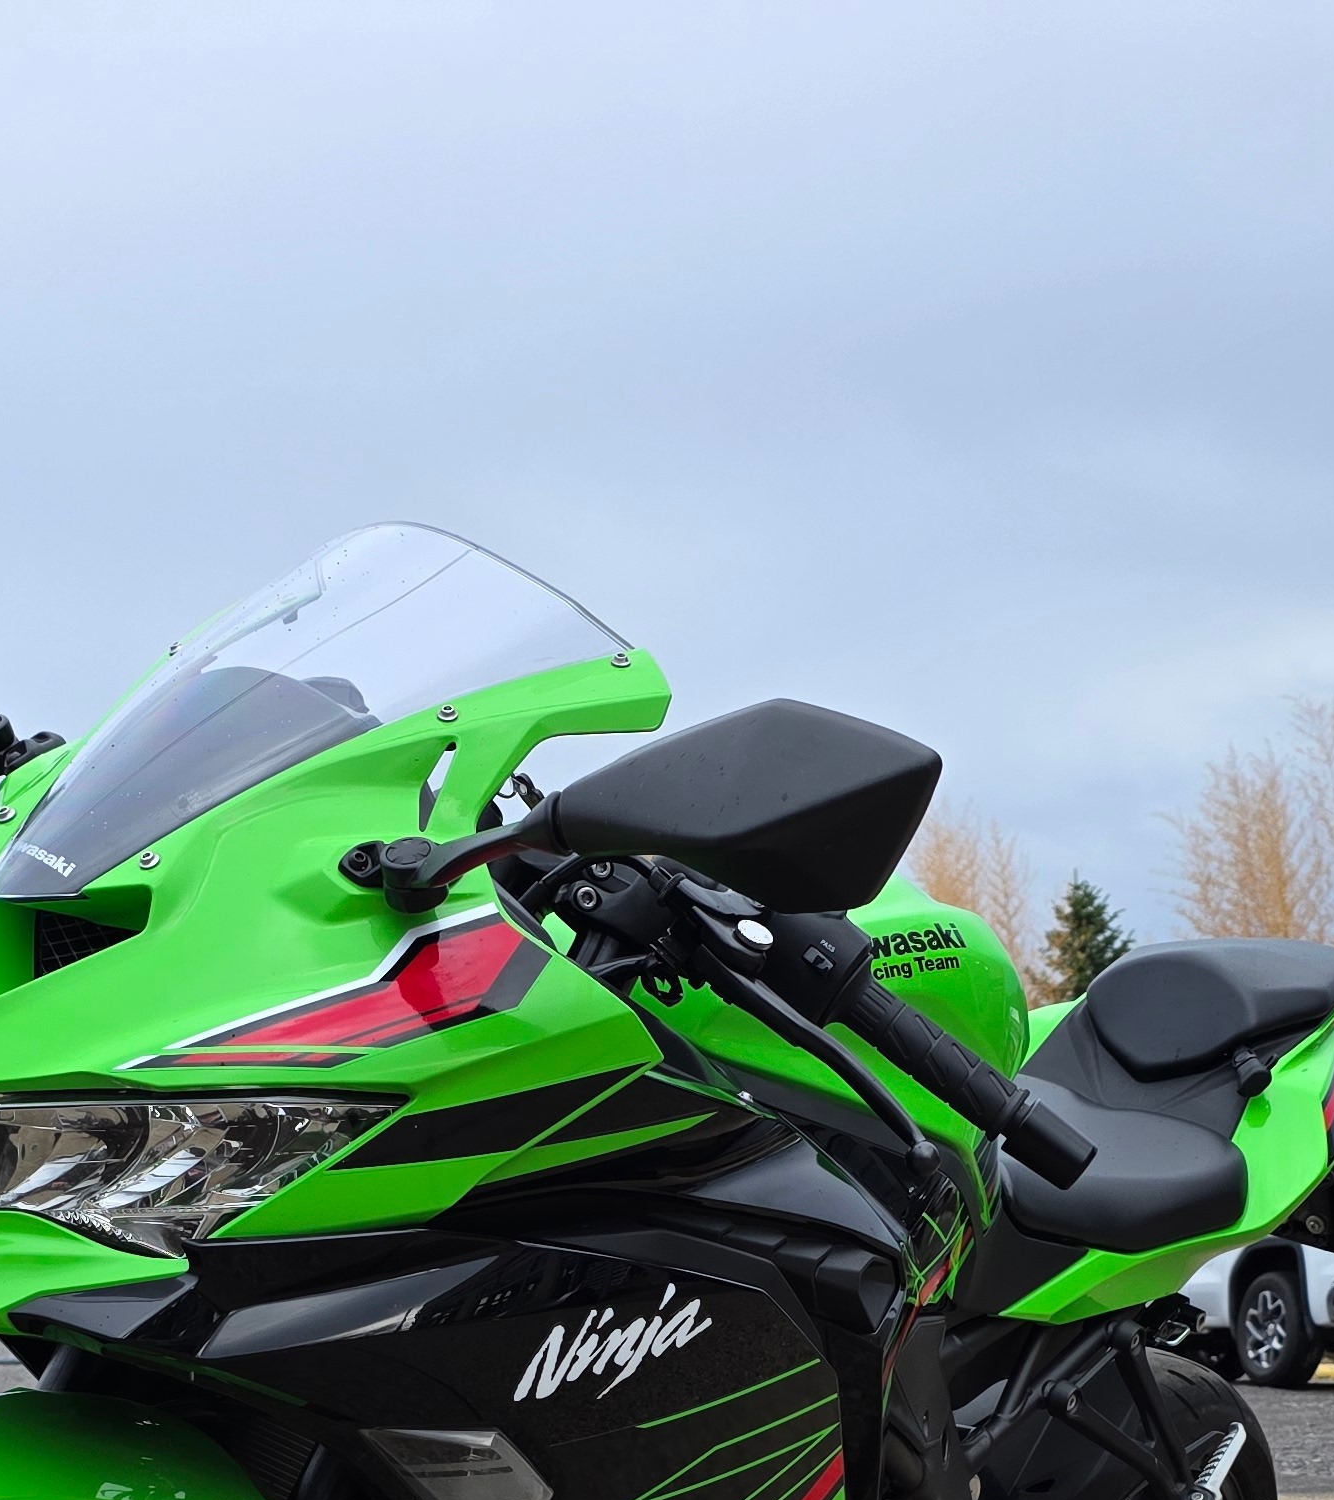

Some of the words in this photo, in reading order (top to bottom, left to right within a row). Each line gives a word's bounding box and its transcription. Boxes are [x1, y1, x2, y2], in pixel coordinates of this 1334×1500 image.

[16, 841, 77, 878] wasaki
[819, 938, 836, 953] PASS
[870, 922, 967, 960] wasaki
[872, 962, 913, 981] cing
[913, 956, 961, 973] Team
[513, 1282, 713, 1402] Ninja
